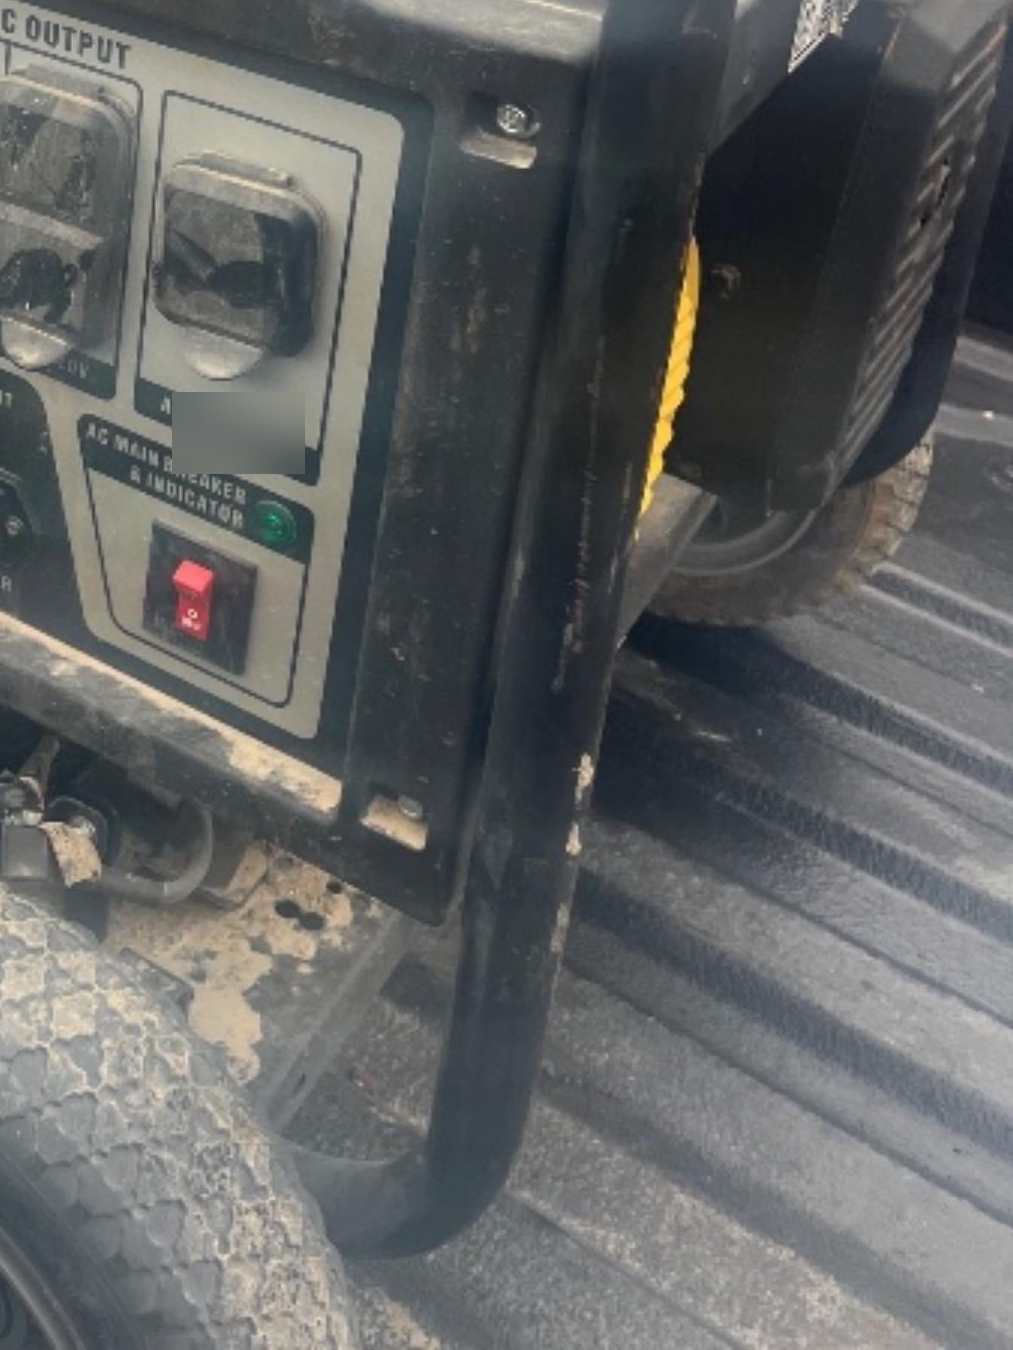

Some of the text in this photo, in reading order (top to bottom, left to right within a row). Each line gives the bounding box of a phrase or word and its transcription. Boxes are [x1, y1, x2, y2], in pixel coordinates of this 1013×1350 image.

[25, 14, 131, 69] OUTPUT
[86, 422, 109, 446] AC
[114, 434, 159, 467] MAIN
[145, 472, 244, 529] INDICATOR
